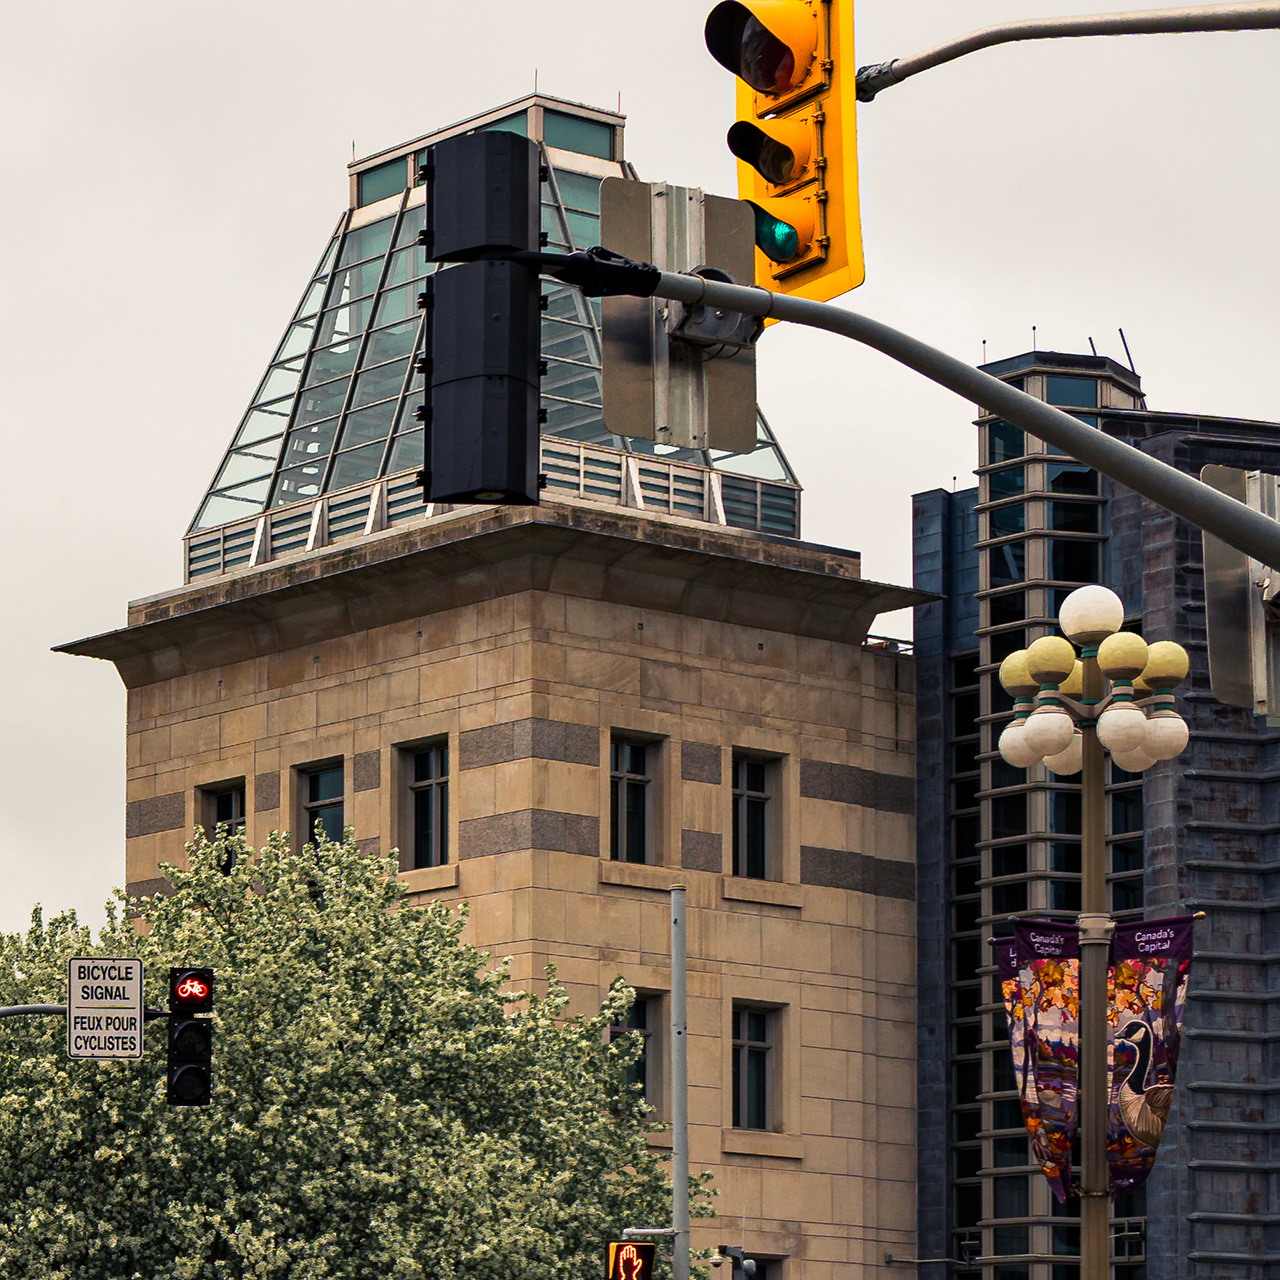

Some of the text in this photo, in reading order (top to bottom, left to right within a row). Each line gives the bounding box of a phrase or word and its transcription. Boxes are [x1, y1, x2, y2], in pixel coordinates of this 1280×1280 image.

[1030, 932, 1065, 945] Canada's
[1135, 929, 1174, 941] Canada's
[1138, 940, 1170, 953] Capital
[77, 965, 134, 981] BICYCLE
[81, 985, 130, 1001] SIGNAL
[73, 1015, 137, 1031] FEUX POUR
[74, 1035, 136, 1051] CYCLISTES
